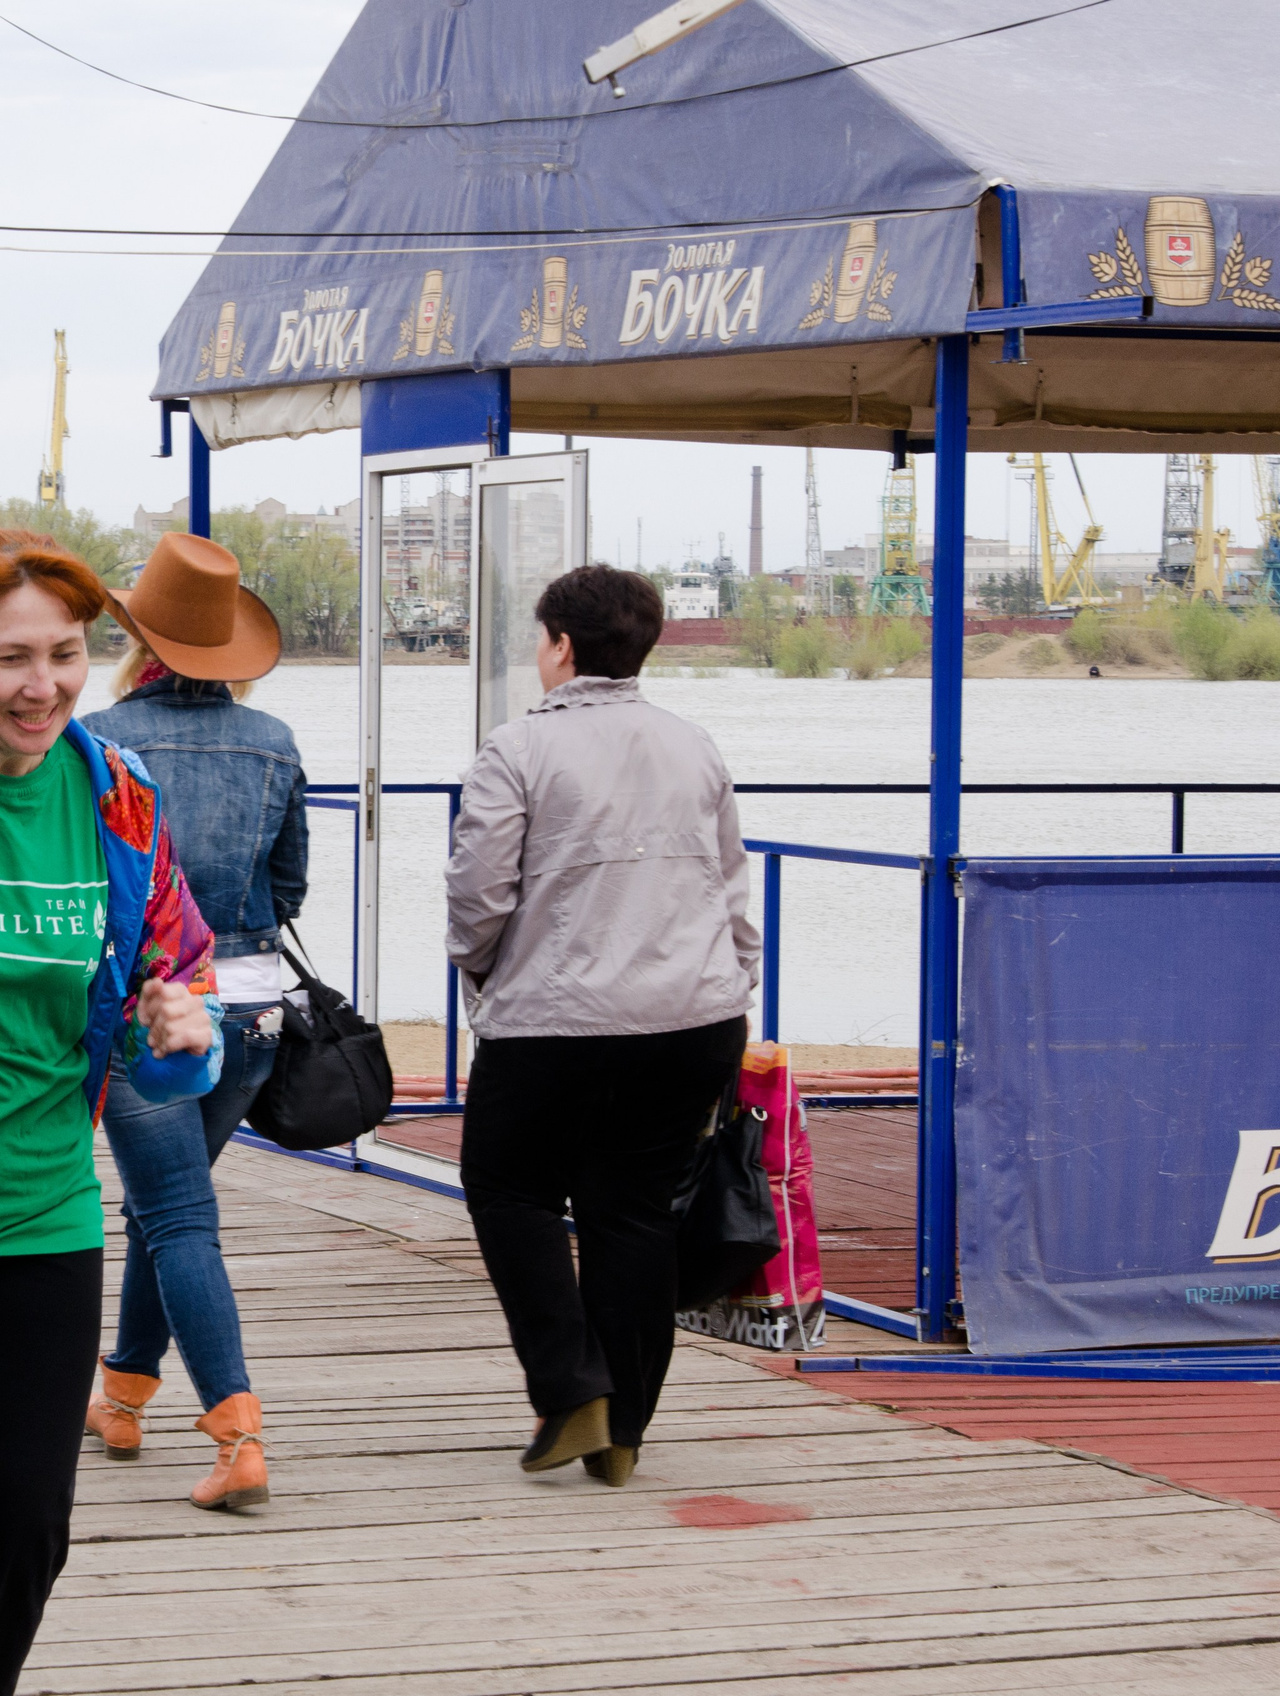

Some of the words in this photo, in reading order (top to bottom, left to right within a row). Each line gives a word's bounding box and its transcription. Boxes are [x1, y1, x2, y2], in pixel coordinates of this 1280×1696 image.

[618, 266, 765, 346] БОЧКА
[268, 308, 369, 373] БОЧКА
[46, 899, 86, 910] TEAM
[726, 1308, 789, 1349] Markt
